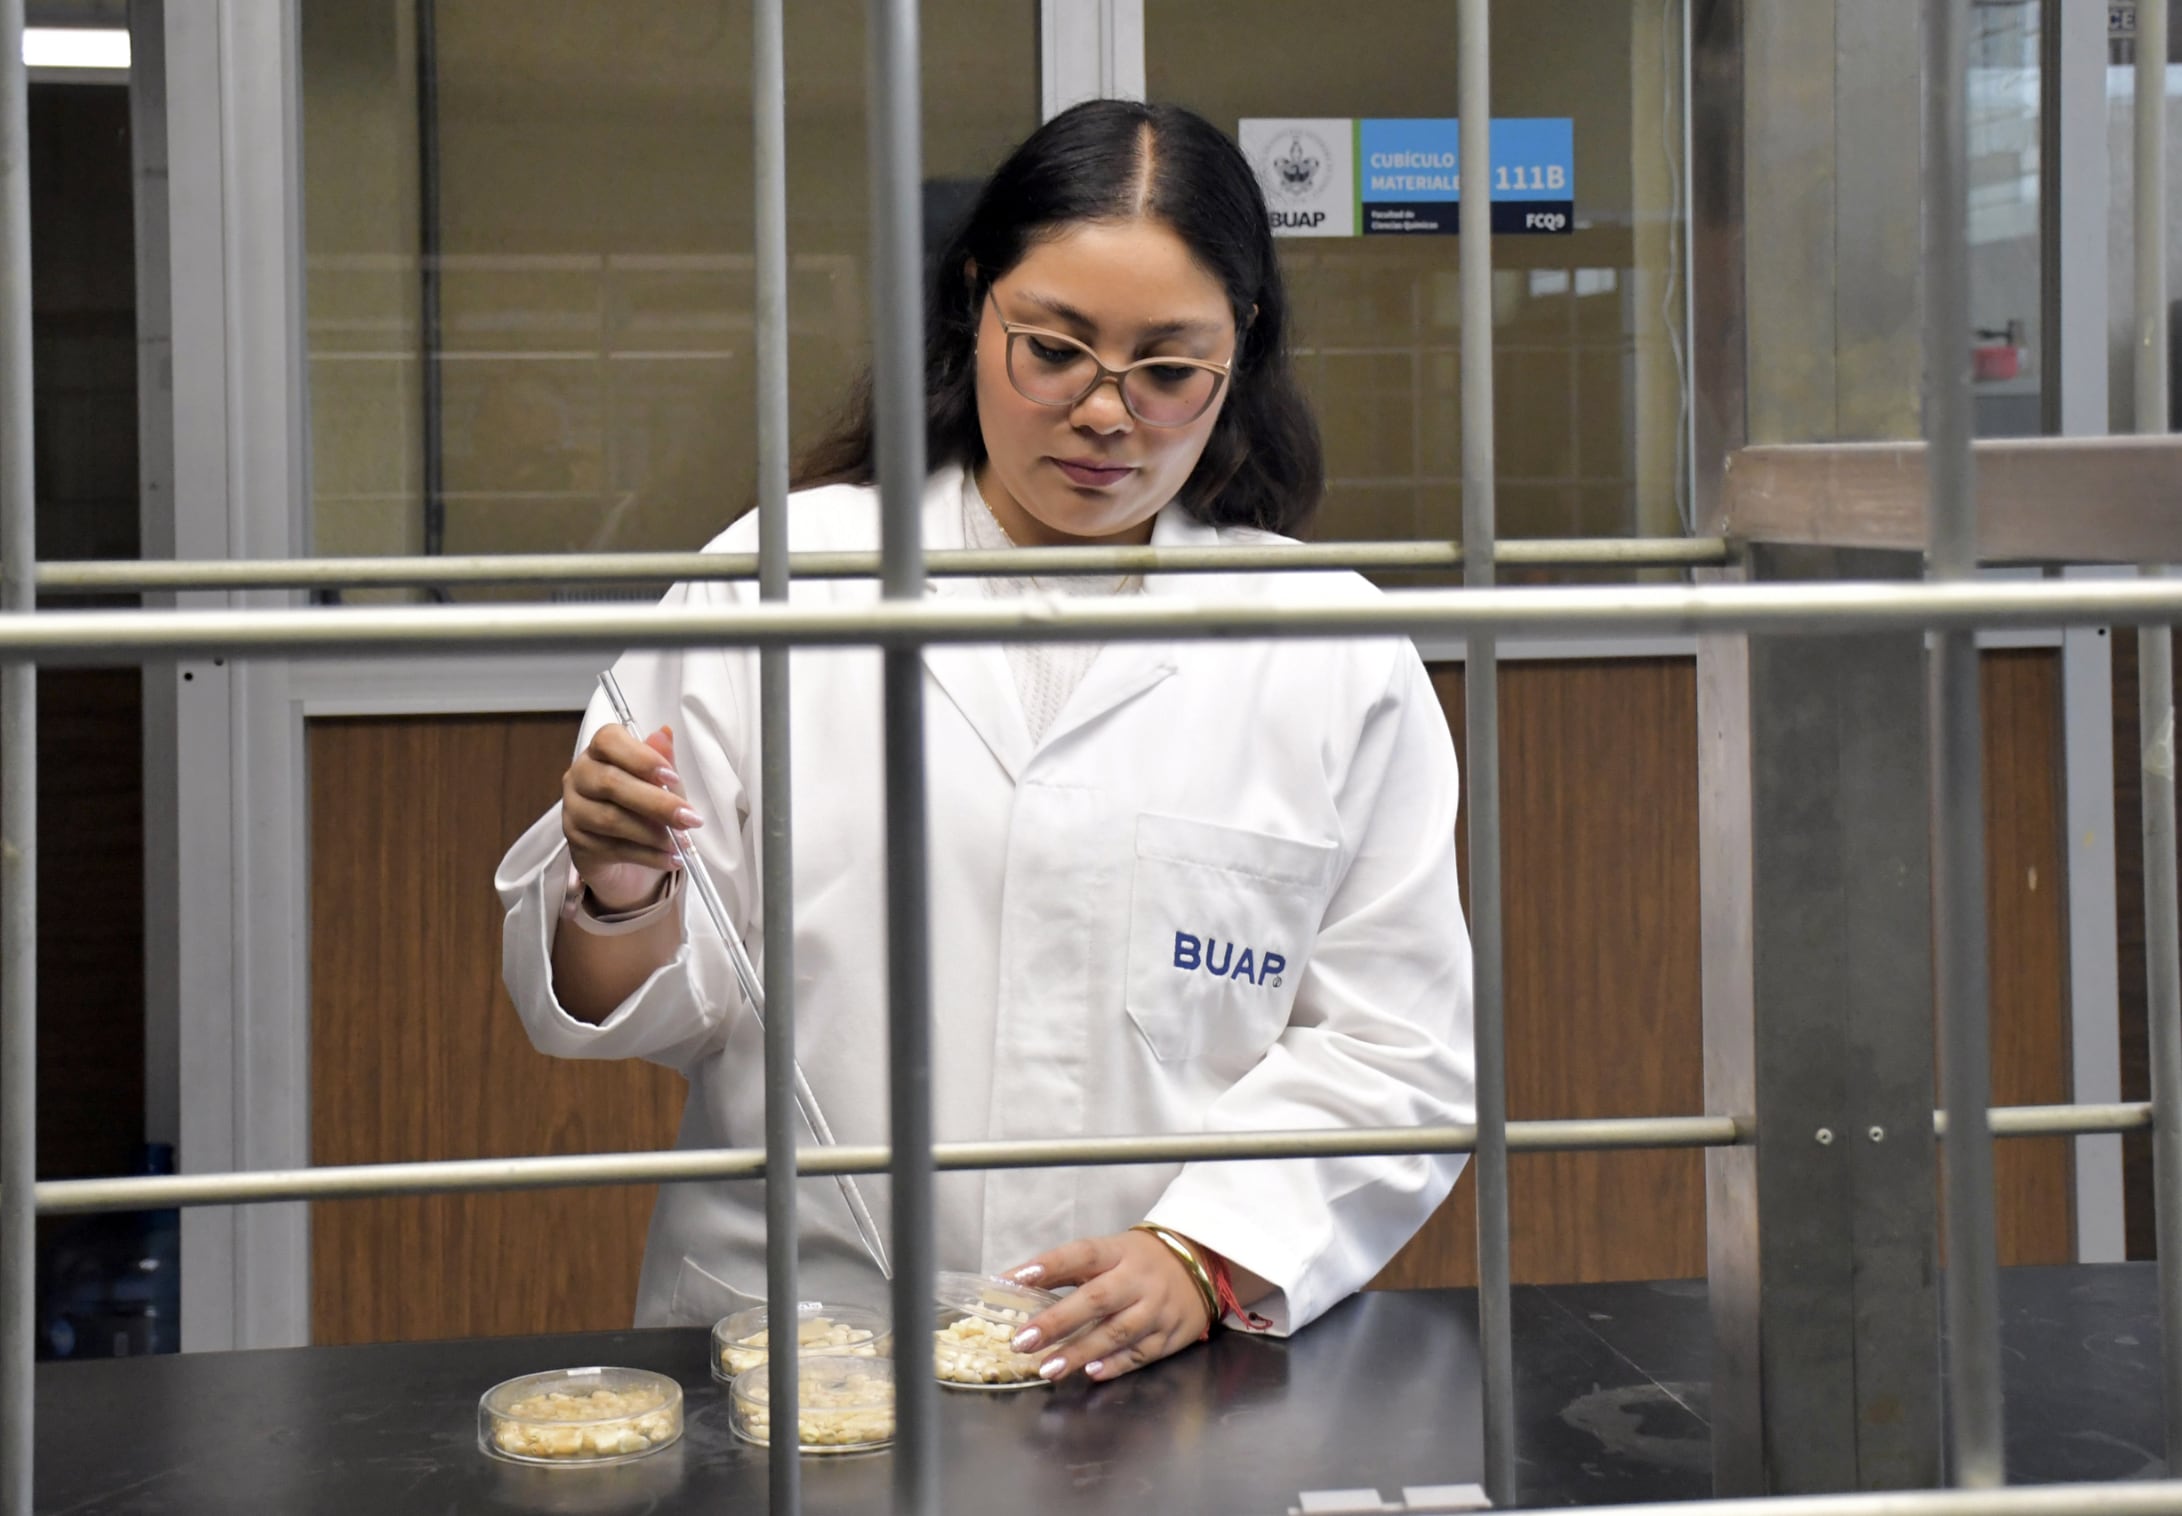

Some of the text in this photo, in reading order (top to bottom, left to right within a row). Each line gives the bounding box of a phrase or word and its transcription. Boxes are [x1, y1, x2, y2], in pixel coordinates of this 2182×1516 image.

[1371, 149, 1455, 169] CUBÍCULO
[1496, 165, 1565, 190] 111B
[1270, 211, 1326, 228] BUAP
